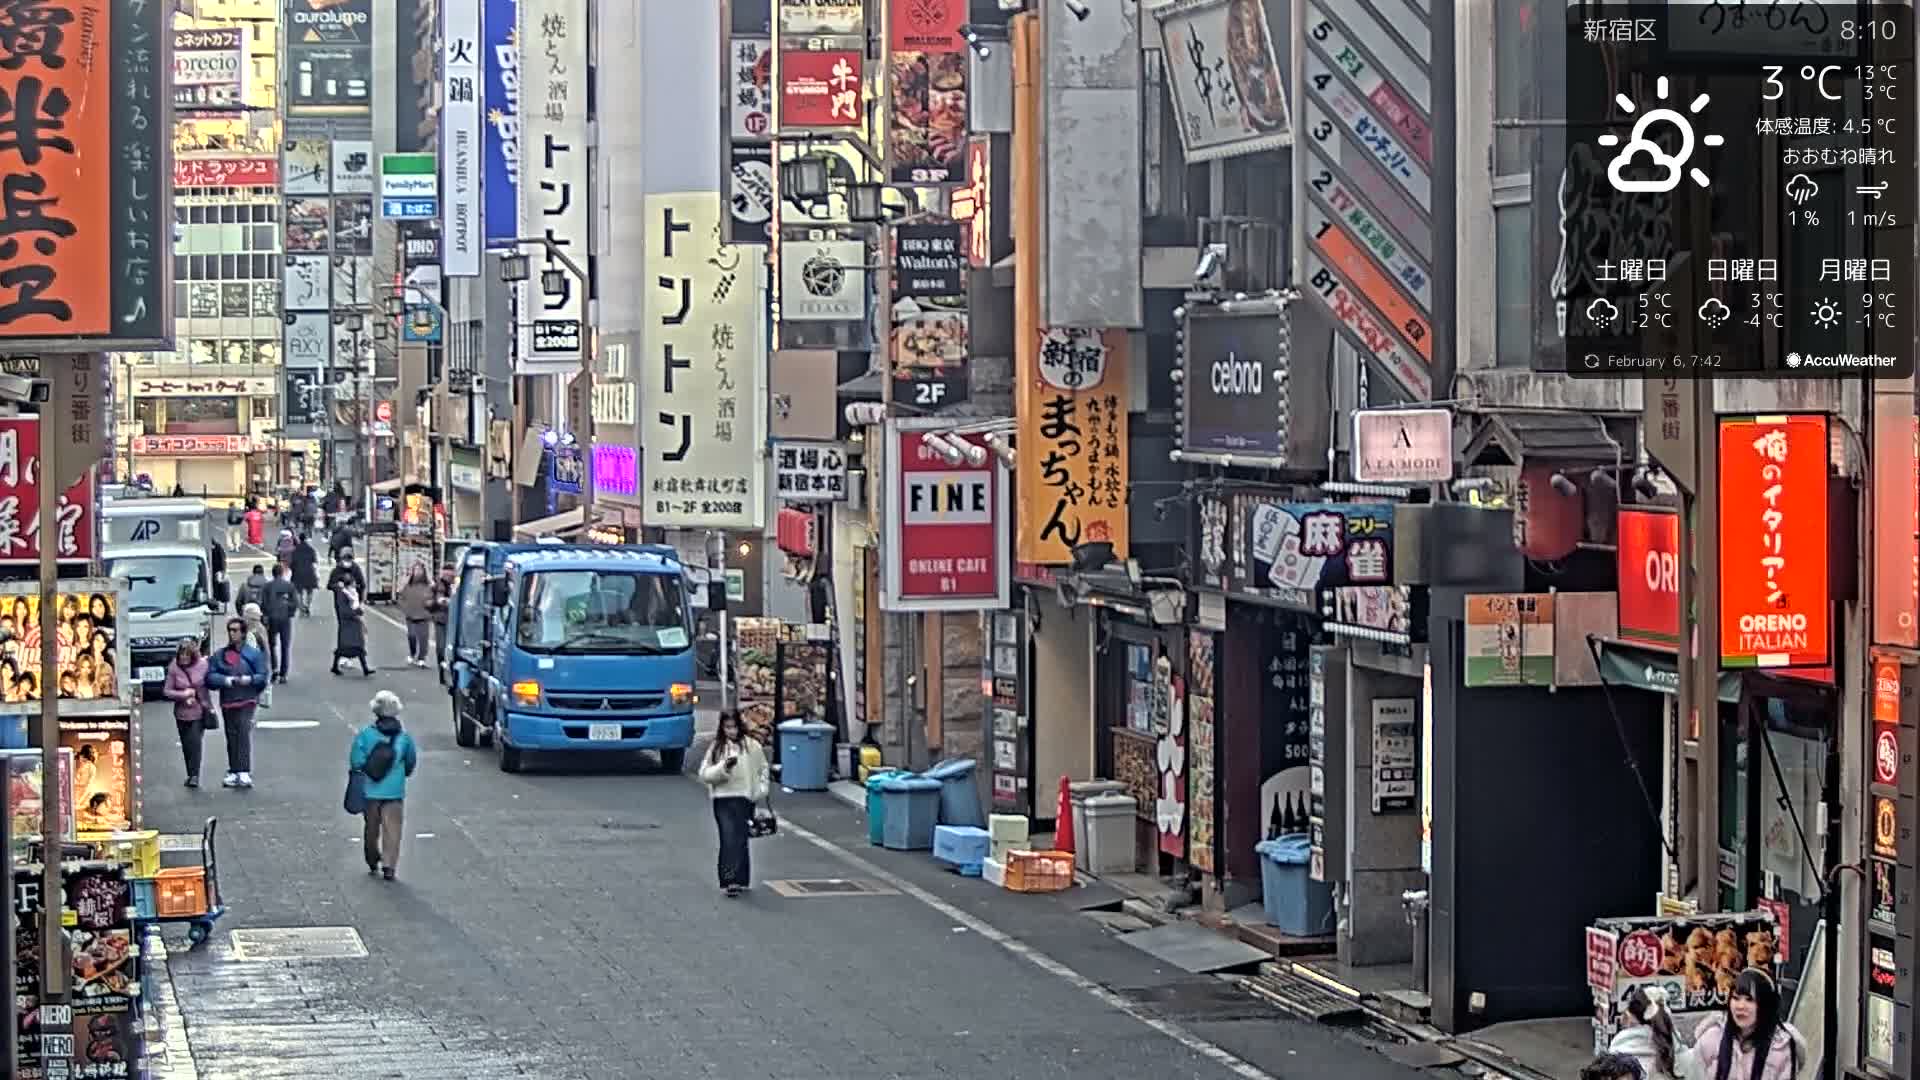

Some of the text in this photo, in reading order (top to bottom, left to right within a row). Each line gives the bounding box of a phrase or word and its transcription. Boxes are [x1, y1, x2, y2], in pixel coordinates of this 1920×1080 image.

[1313, 21, 1333, 41] 5
[449, 38, 473, 103] 火鍋
[829, 57, 858, 119] 牛門
[1313, 74, 1331, 90] 4
[1314, 121, 1332, 141] 3
[1312, 171, 1332, 192] 2
[900, 255, 958, 271] Walton's
[1311, 268, 1338, 297] B1
[658, 207, 692, 462] トントン
[1211, 352, 1263, 394] celona
[71, 354, 91, 445] 通り一番街
[914, 382, 946, 403] 2F
[777, 449, 844, 471] 酒場心
[1039, 395, 1085, 548] まっちゃん
[777, 474, 845, 493] 新宿本店
[910, 483, 986, 512] FINE
[1348, 516, 1388, 535] フリー
[1753, 429, 1789, 603] 俺のイタリアン
[909, 558, 988, 573] ONLINE CAFE
[1739, 613, 1808, 632] ORENO
[1739, 634, 1808, 650] ITALIAN
[41, 1005, 71, 1024] NERO
[42, 1036, 73, 1054] NERO
